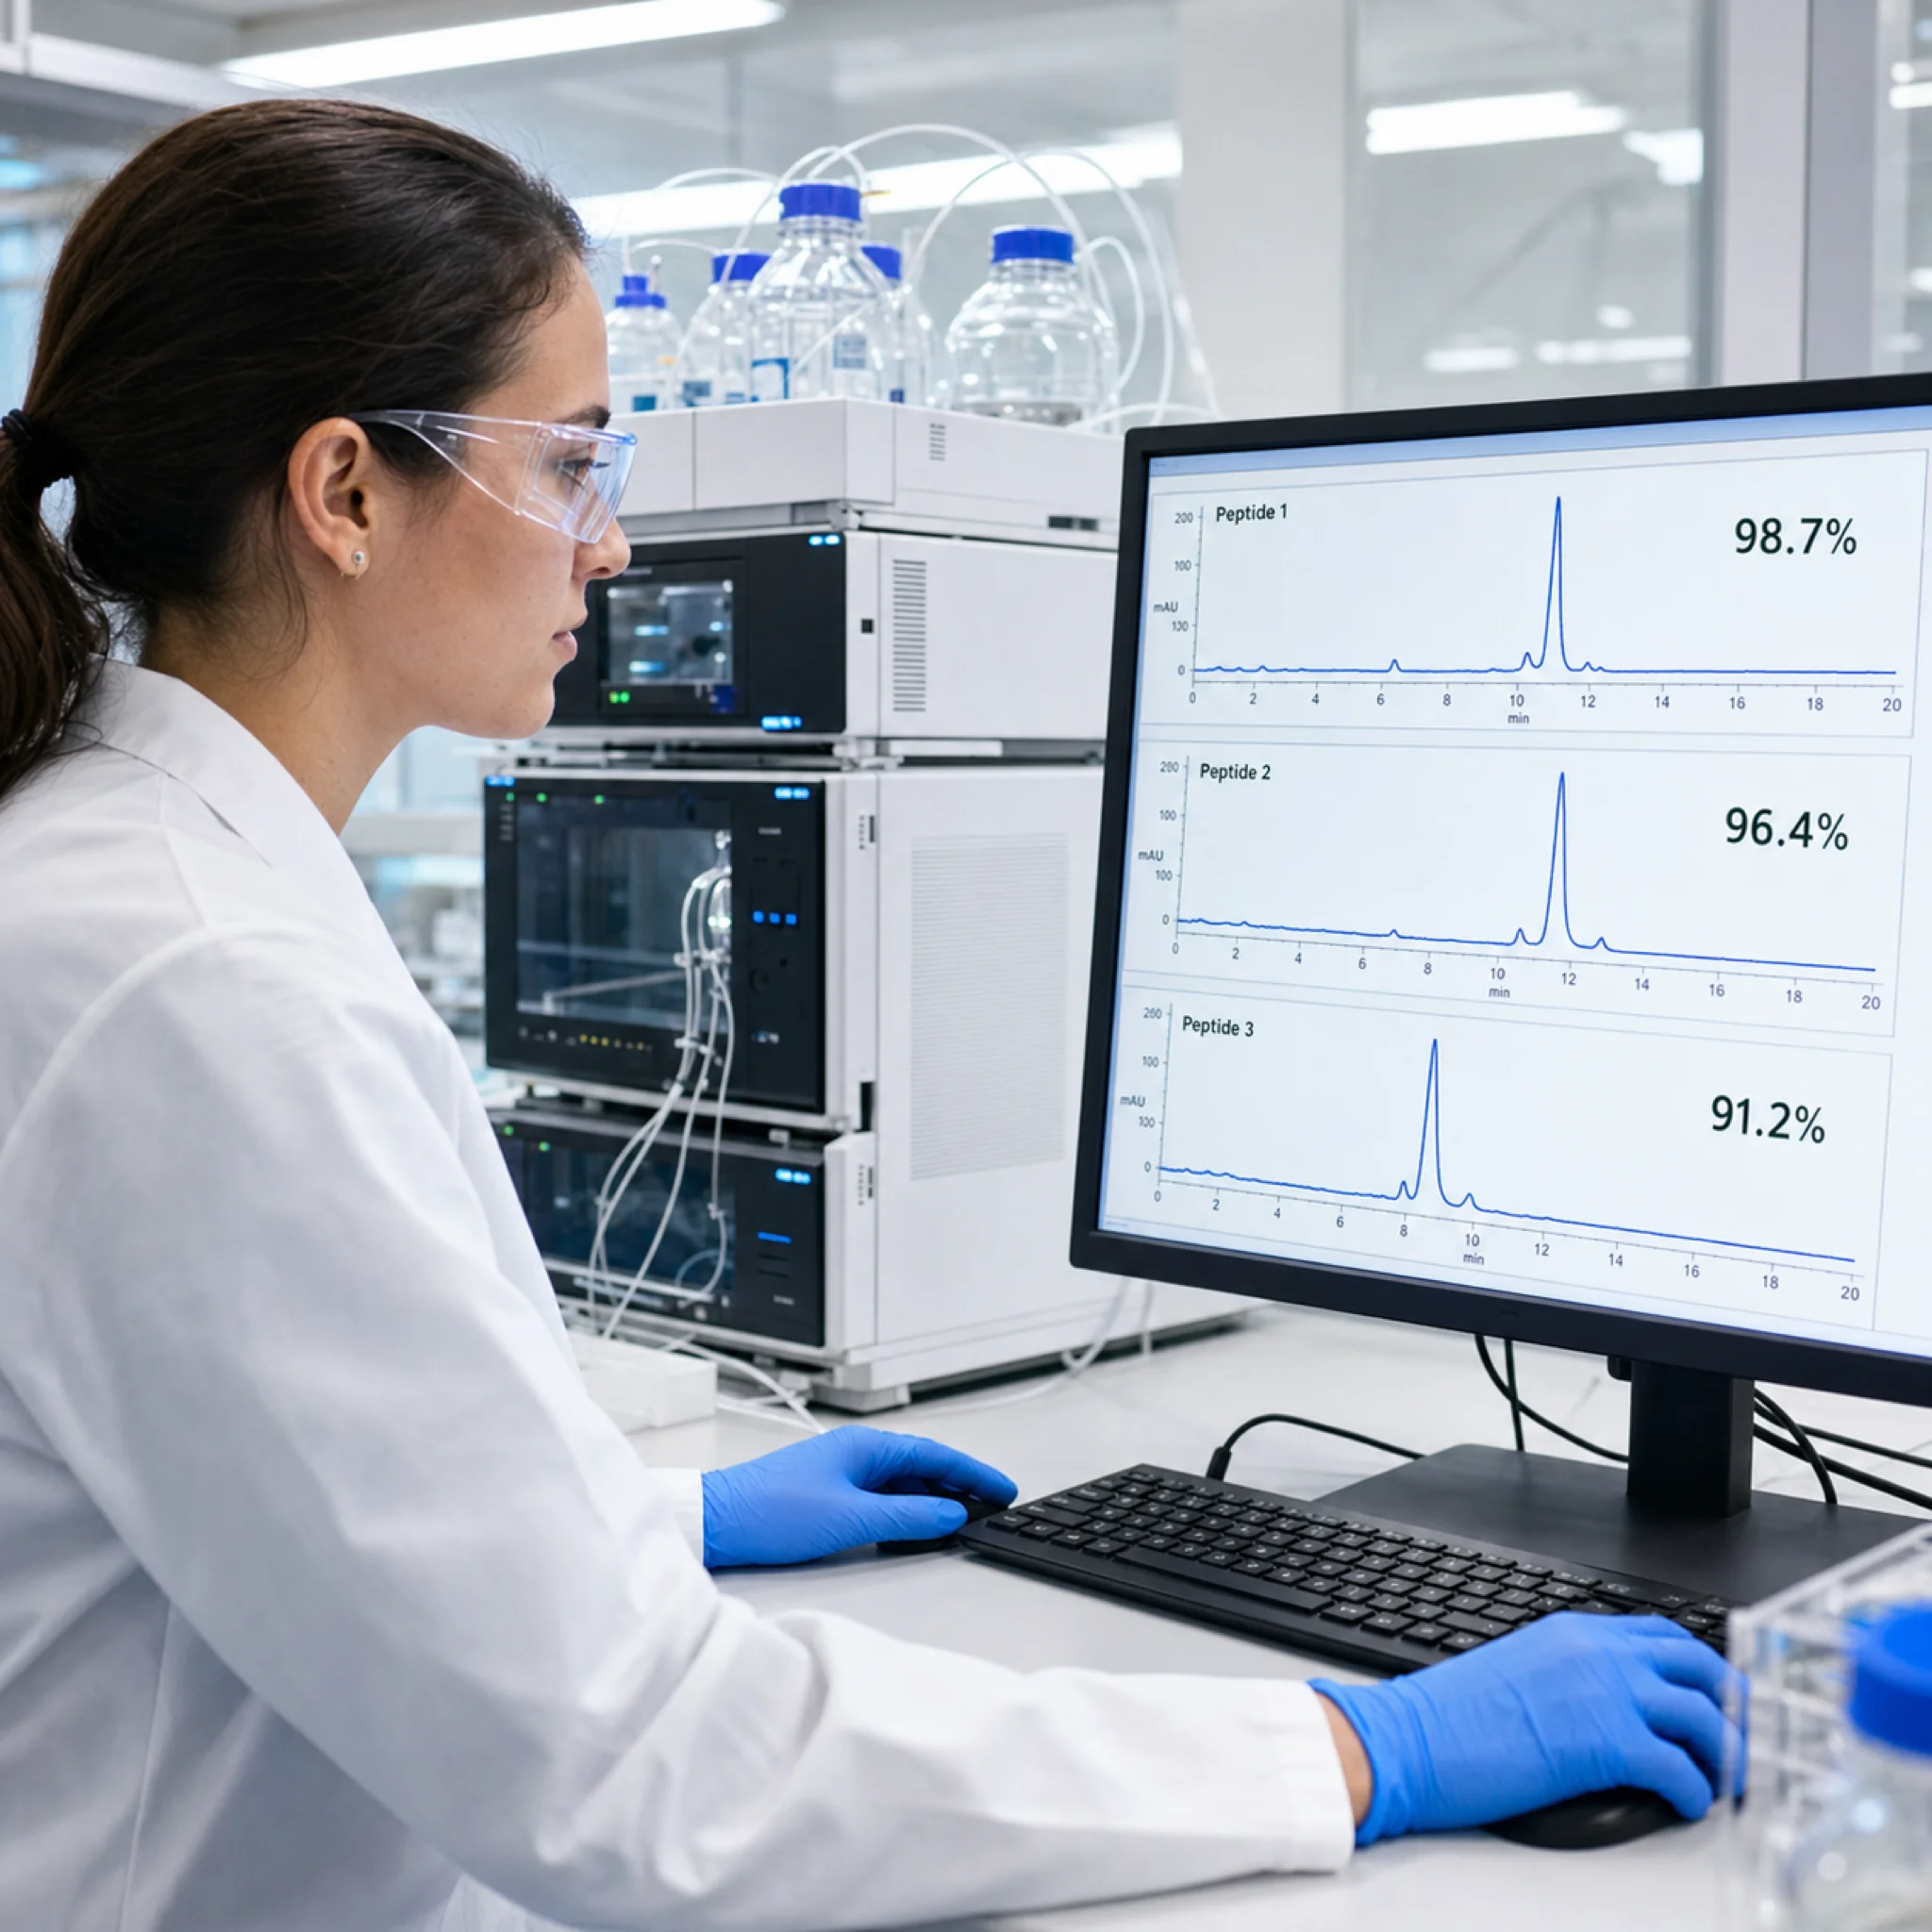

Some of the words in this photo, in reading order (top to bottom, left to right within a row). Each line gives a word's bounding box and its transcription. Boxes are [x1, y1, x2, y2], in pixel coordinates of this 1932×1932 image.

[1217, 504, 1274, 525] Peptide
[1280, 503, 1288, 519] 1
[1736, 518, 1857, 555] 98.7%
[1153, 601, 1179, 614] mAU
[1177, 664, 1186, 676] 0
[1189, 691, 1197, 705] 0
[1249, 691, 1257, 705] 2
[1311, 692, 1320, 705] 4
[1376, 692, 1386, 707] 6
[1442, 692, 1452, 707] 8
[1509, 693, 1524, 708] 10
[1581, 693, 1596, 708] 12
[1655, 695, 1670, 708] 14
[1729, 695, 1746, 710] 16
[1807, 697, 1824, 711] 18
[1882, 697, 1902, 712] 20
[1507, 711, 1530, 724] min
[1200, 763, 1257, 783] Peptide
[1261, 763, 1271, 780] 2
[1726, 808, 1848, 850] 96.4%
[1138, 849, 1164, 862] mAU
[1161, 913, 1171, 925] 0
[1172, 941, 1180, 955] 0
[1231, 946, 1240, 960] 2
[1294, 952, 1303, 964] 4
[1357, 957, 1367, 970] 6
[1423, 962, 1432, 975] 8
[1491, 967, 1507, 981] 10
[1561, 972, 1577, 986] 12
[1634, 977, 1650, 991] 14
[1709, 983, 1725, 998] 16
[1786, 990, 1804, 1004] 18
[1861, 994, 1881, 1010] 20
[1489, 985, 1510, 998] min
[1183, 1016, 1239, 1037] Peptide
[1244, 1021, 1254, 1038] 3
[1119, 1094, 1146, 1108] mAU
[1712, 1095, 1824, 1143] 91.2%
[1143, 1160, 1152, 1174] 0
[1153, 1190, 1162, 1203] 0
[1212, 1198, 1220, 1211] 2
[1274, 1208, 1281, 1220] 4
[1336, 1215, 1344, 1229] 6
[1399, 1224, 1408, 1238] 8
[1465, 1233, 1480, 1247] 10
[1534, 1242, 1550, 1257] 12
[1608, 1253, 1624, 1267] 14
[1684, 1263, 1700, 1278] 16
[1762, 1274, 1779, 1291] 18
[1840, 1286, 1860, 1302] 20
[1462, 1252, 1485, 1266] min
